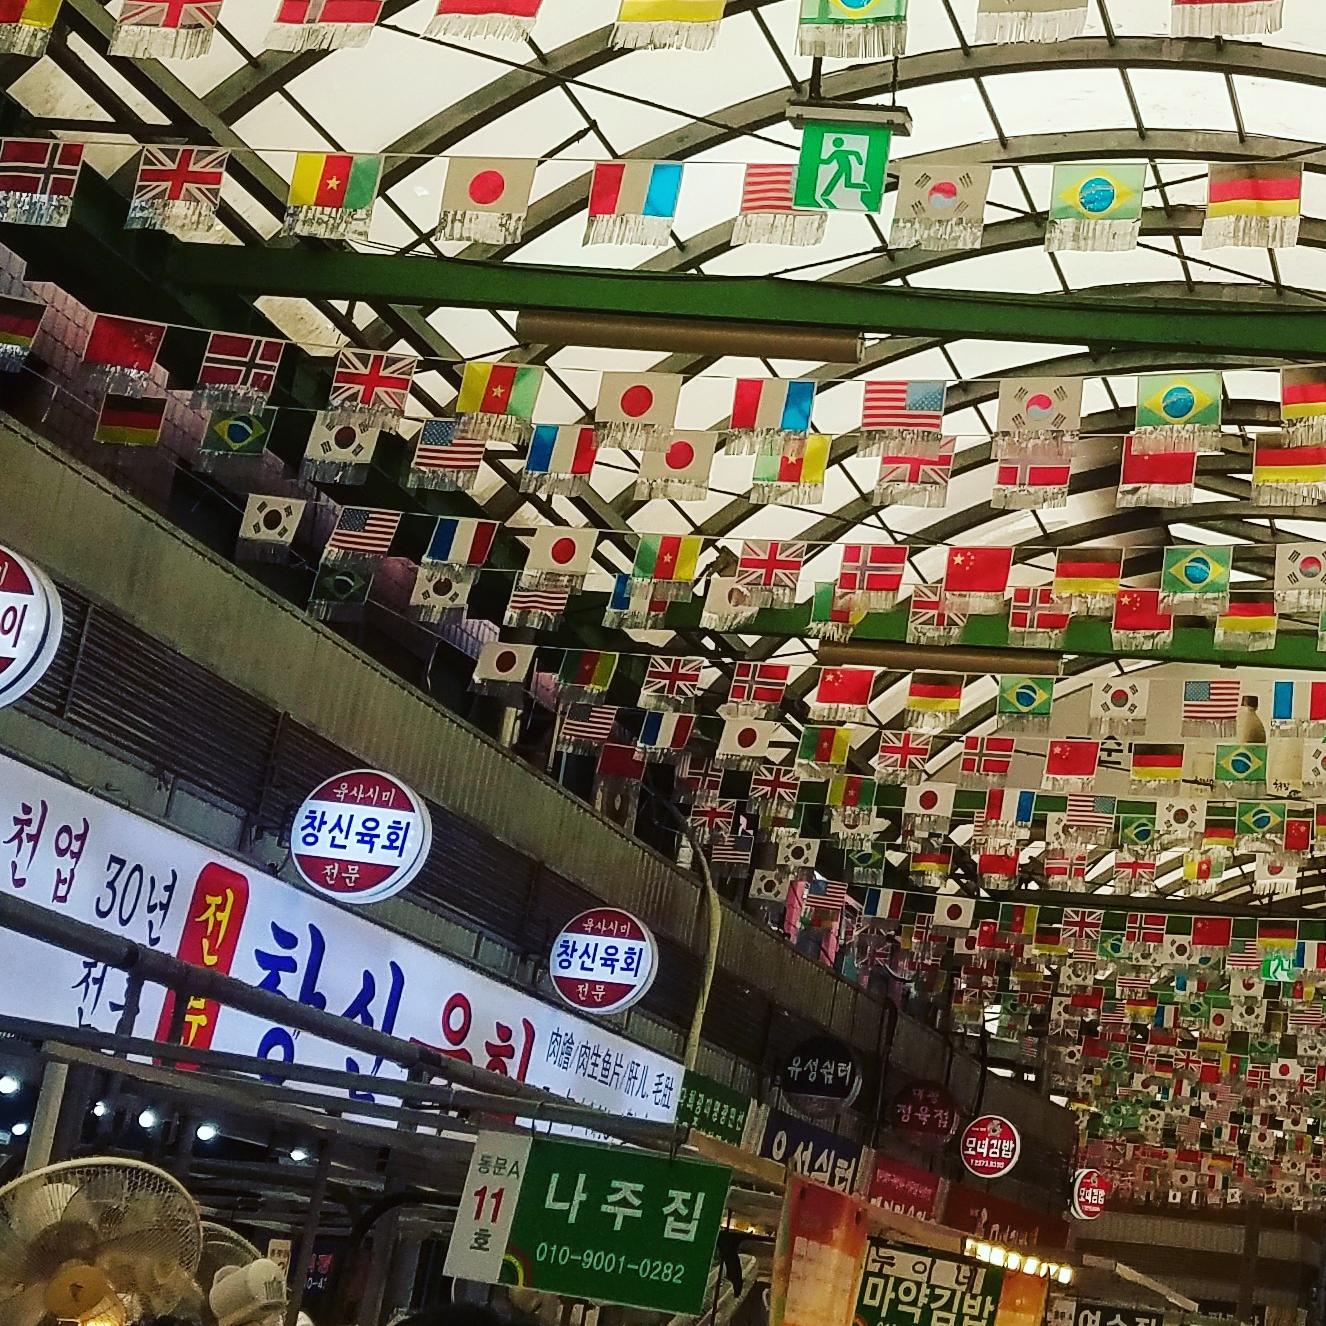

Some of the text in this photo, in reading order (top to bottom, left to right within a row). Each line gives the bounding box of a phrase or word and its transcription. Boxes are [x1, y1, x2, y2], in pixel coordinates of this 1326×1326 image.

[333, 783, 396, 807] 육사시미
[301, 810, 411, 858] 창신육회
[3, 800, 178, 946] 천엽 30년
[322, 862, 360, 887] 전문
[582, 918, 631, 937] 육사시미
[557, 940, 643, 977] 창신육회
[577, 983, 606, 1002] 전문
[788, 1056, 852, 1086] 유성쉼터
[964, 1137, 1014, 1159] 모녀김밥
[478, 1154, 520, 1179] 동문A
[474, 1185, 504, 1223] 11
[545, 1173, 705, 1242] 나주집
[469, 1228, 491, 1252] 호
[536, 1242, 686, 1284] 010-9001-0282
[863, 1275, 996, 1326] 마약김밥
